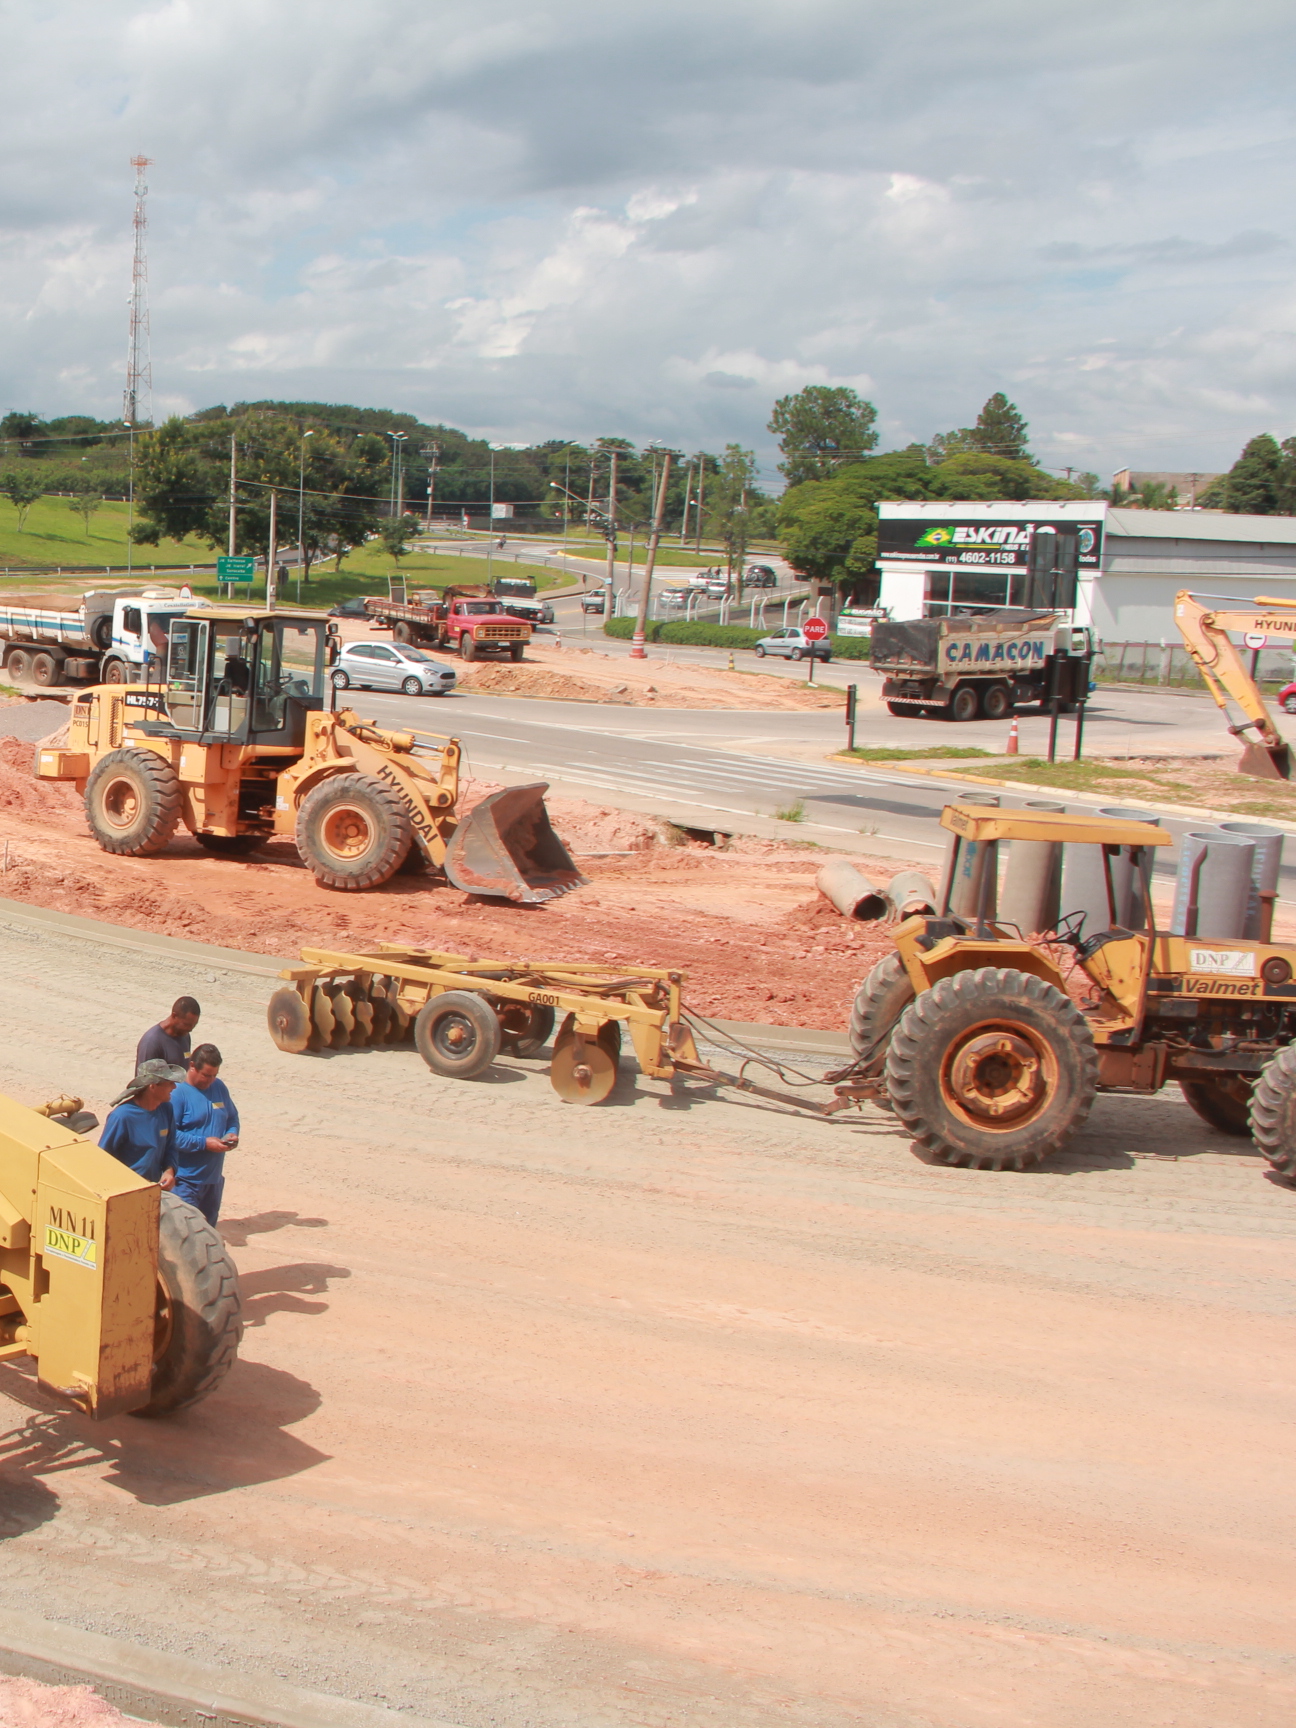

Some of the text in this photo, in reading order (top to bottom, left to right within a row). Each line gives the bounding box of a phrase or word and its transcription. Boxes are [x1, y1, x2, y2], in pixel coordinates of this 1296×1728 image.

[945, 552, 1016, 564] (11) 4602-1158
[804, 625, 825, 633] PARE
[1254, 619, 1296, 632] HYUN
[946, 641, 1044, 662] CAMACON
[376, 765, 439, 844] HYUNDAI
[1195, 952, 1229, 966] DNP
[1185, 979, 1260, 996] Valmet
[528, 992, 560, 1006] GA001
[49, 1205, 95, 1240] MN 11
[47, 1229, 81, 1254] DNP
